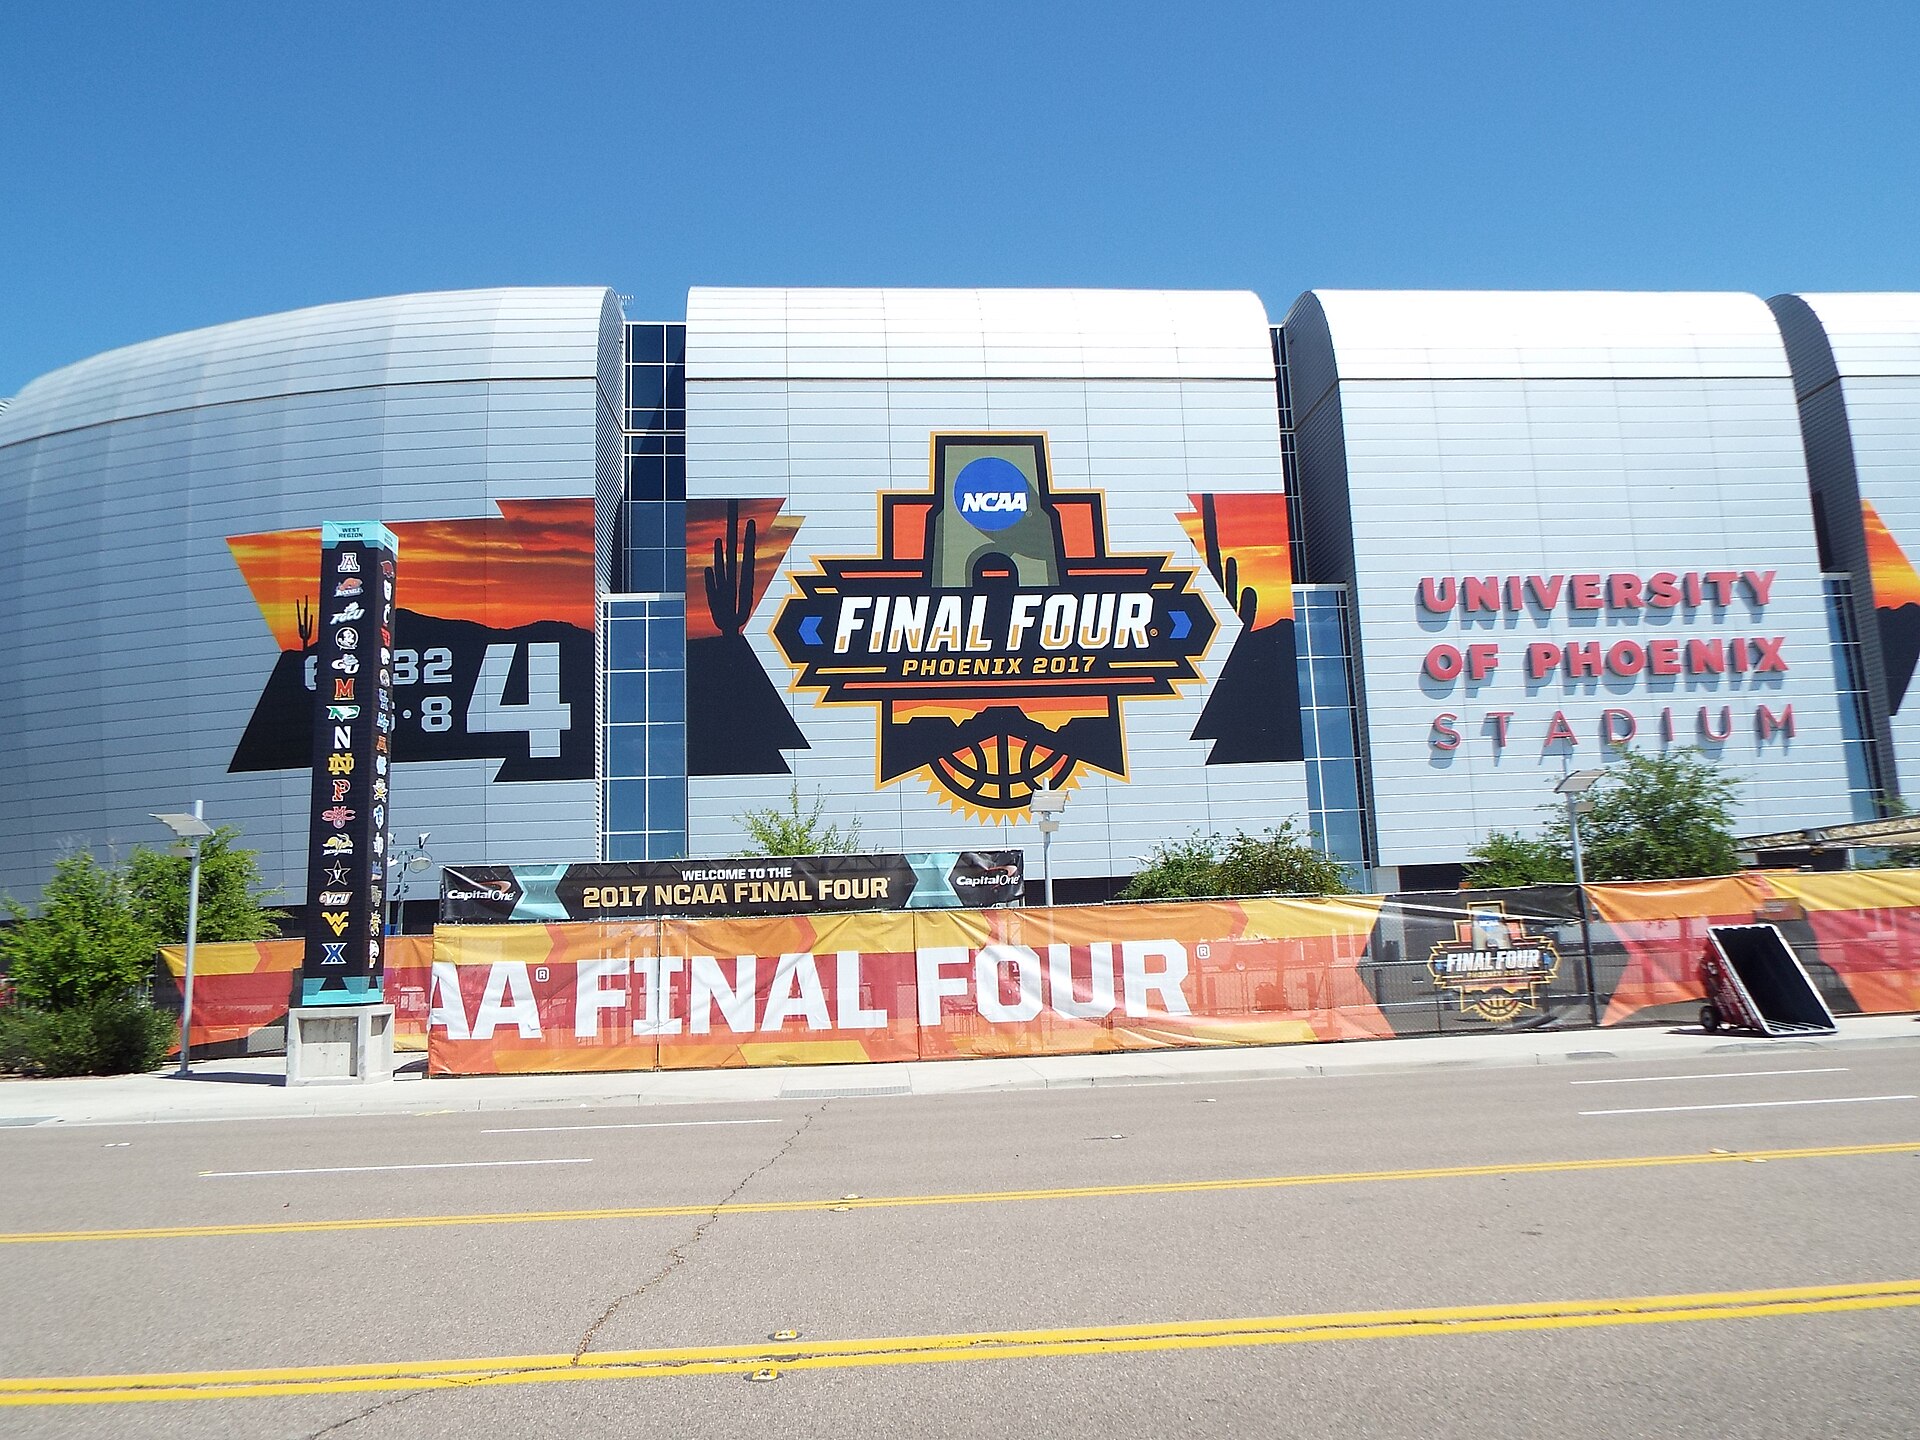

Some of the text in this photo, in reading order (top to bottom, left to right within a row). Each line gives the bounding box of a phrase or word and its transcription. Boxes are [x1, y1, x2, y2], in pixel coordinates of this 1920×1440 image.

[961, 492, 1028, 512] NCAA
[337, 552, 361, 573] A
[1418, 570, 1777, 614] UNIVERSITY
[833, 592, 1155, 654] FINAL FOUR
[393, 647, 452, 686] 32
[902, 656, 1096, 676] PHOENIX 2017
[1422, 636, 1790, 682] OF PHOENIX
[334, 678, 355, 701] M
[466, 642, 572, 759] 4
[334, 725, 351, 749] N
[1430, 703, 1797, 751] STADIUM
[332, 779, 351, 802] P
[682, 867, 792, 882] WELCOME TO THE
[325, 892, 352, 905] VCU
[583, 877, 889, 908] 2017 NCAA FINAL FOUR
[321, 942, 348, 965] X
[1446, 949, 1540, 972] FINAL FOUR
[575, 951, 888, 1038] FINAL
[916, 939, 1193, 1026] FOUR
